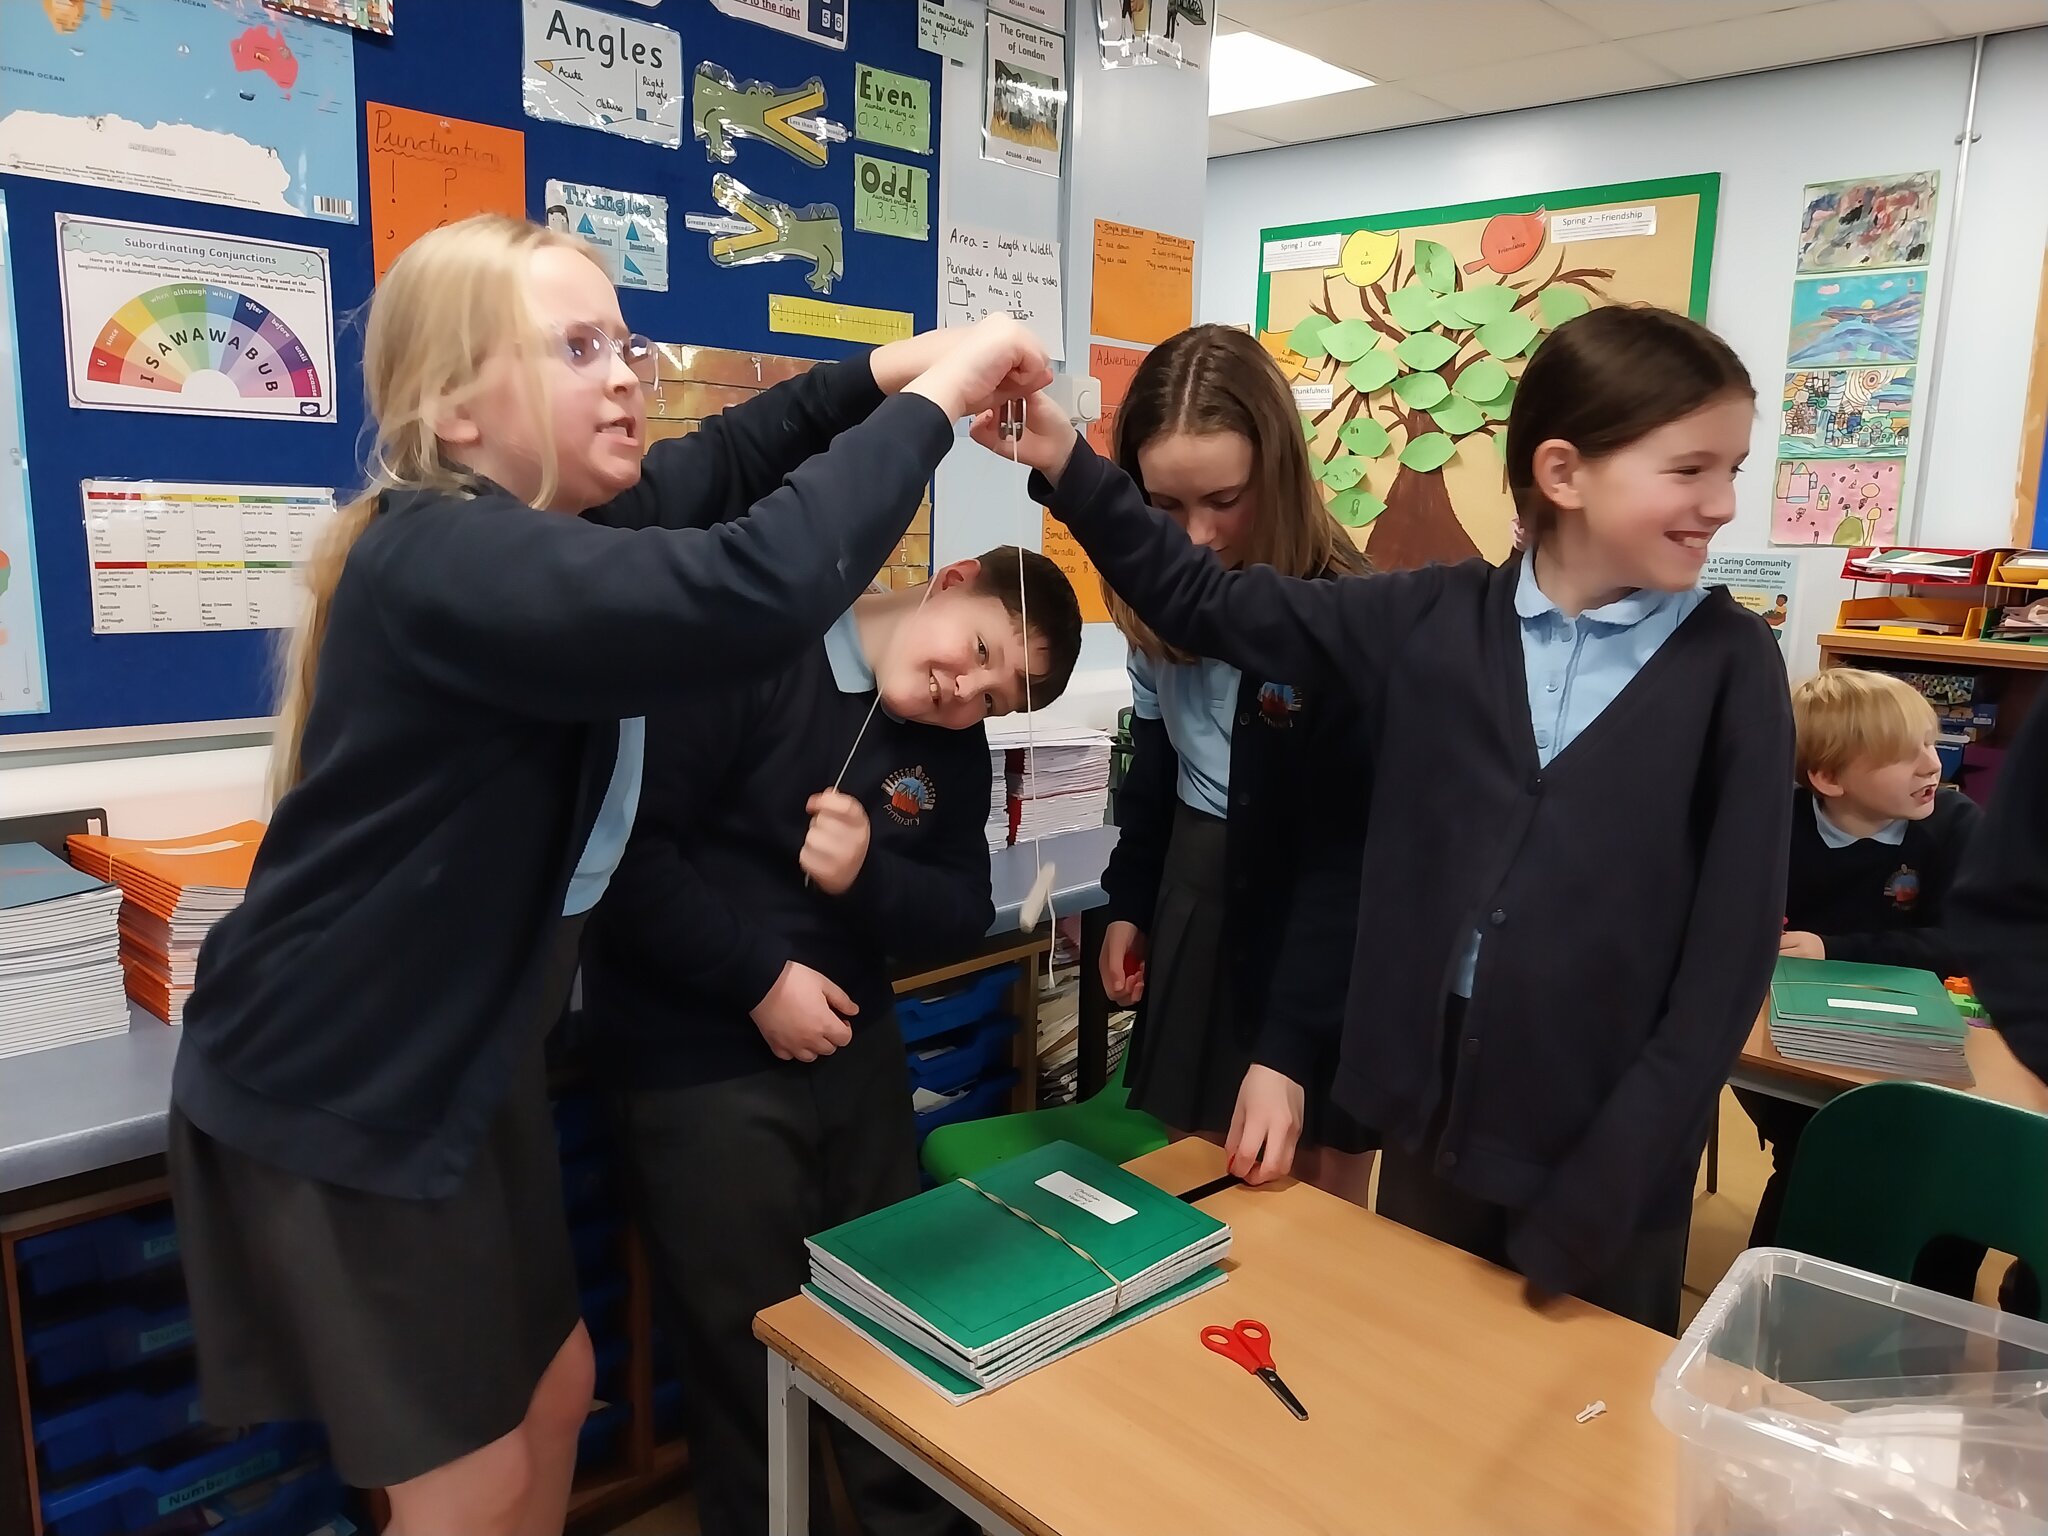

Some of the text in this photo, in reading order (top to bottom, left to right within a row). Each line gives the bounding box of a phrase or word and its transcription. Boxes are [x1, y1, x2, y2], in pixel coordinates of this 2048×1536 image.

[762, 0, 801, 19] the right
[923, 5, 936, 15] How
[939, 12, 956, 26] many
[920, 27, 928, 36] to
[921, 18, 969, 38] are equivalent
[1000, 23, 1054, 48] The Great Fire
[546, 9, 663, 69] Angles
[1008, 42, 1046, 61] of London
[37, 72, 65, 82] OCEAN
[558, 66, 584, 81] Acute
[642, 76, 664, 94] Right
[860, 70, 916, 110] Even.
[596, 98, 624, 113] Obtuse
[646, 89, 668, 105] angle
[861, 162, 916, 204] Odd.
[1562, 211, 1643, 227] Spring 2 Friendship
[124, 237, 278, 266] Subordinating Conjunctions
[950, 228, 978, 248] Area
[998, 234, 1020, 258] Length
[1280, 242, 1299, 252] Spring
[122, 269, 160, 278] subordinating
[182, 268, 220, 277] subordinating
[994, 266, 1008, 280] Add
[1012, 272, 1023, 282] all
[1026, 272, 1039, 284] the
[173, 288, 207, 297] although
[212, 288, 234, 300] while
[988, 284, 1004, 296] Area
[245, 301, 264, 315] after
[271, 318, 290, 338] before
[294, 345, 308, 362] until
[306, 368, 318, 397] because
[1718, 557, 1744, 568] Caring
[1745, 558, 1792, 569] Community
[1759, 568, 1782, 576] Grow
[168, 1474, 225, 1506] Number
